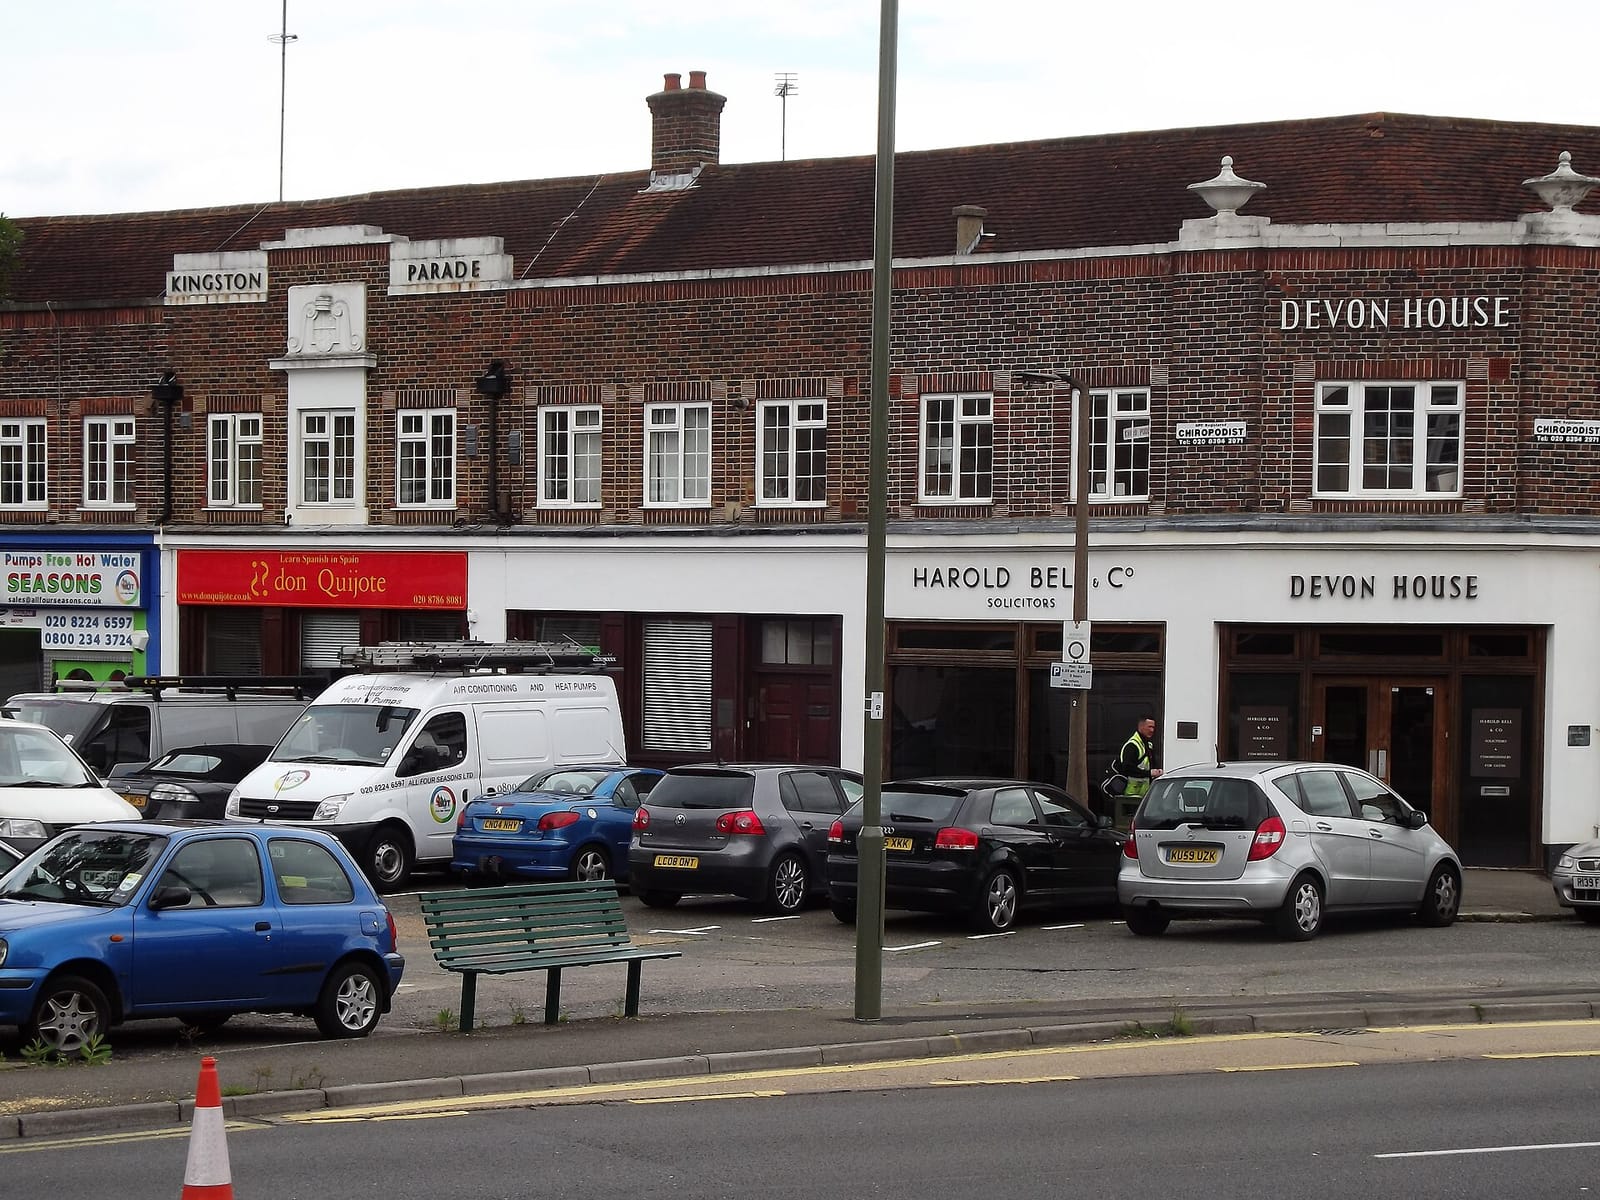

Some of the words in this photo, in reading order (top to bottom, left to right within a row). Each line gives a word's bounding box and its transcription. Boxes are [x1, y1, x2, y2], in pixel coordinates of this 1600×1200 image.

[171, 272, 262, 292] KINGSTON
[407, 260, 480, 282] PARADE
[1280, 298, 1389, 330] DEVON
[1403, 296, 1510, 328] HOUSE
[1178, 428, 1244, 438] CHIROPODIST
[1536, 425, 1600, 434] CHIROPODIST
[5, 554, 42, 568] Pumps
[46, 554, 72, 567] Free
[76, 554, 95, 567] Hot
[100, 554, 136, 567] Water
[280, 555, 300, 564] Learn
[301, 555, 329, 565] Spanish
[339, 556, 359, 565] Spain
[7, 572, 102, 593] SEASONS
[274, 568, 306, 591] don
[317, 568, 386, 598] Quijote
[914, 567, 1010, 588] HAROLD
[1030, 567, 1073, 588] BEL
[1092, 577, 1099, 588] &
[1290, 575, 1376, 599] DEVON
[1393, 575, 1478, 599] HOUSE
[413, 595, 426, 604] 020
[428, 595, 444, 605] 8786
[446, 596, 462, 605] 8081
[987, 598, 1056, 609] SOLICITORS
[45, 616, 66, 628] 020
[71, 616, 99, 628] 8224
[104, 617, 132, 629] 6597
[45, 633, 74, 644] 0800
[79, 634, 100, 645] 234
[105, 634, 132, 646] 3724
[453, 685, 466, 694] AIR
[468, 684, 518, 694] CONDITIONING
[555, 682, 572, 691] HEAT
[574, 682, 597, 690] PUMPS
[437, 774, 462, 783] SEASONS
[892, 839, 908, 848] XKK
[658, 857, 677, 865] LC08
[1171, 850, 1194, 860] KU59
[1197, 851, 1215, 860] UZK
